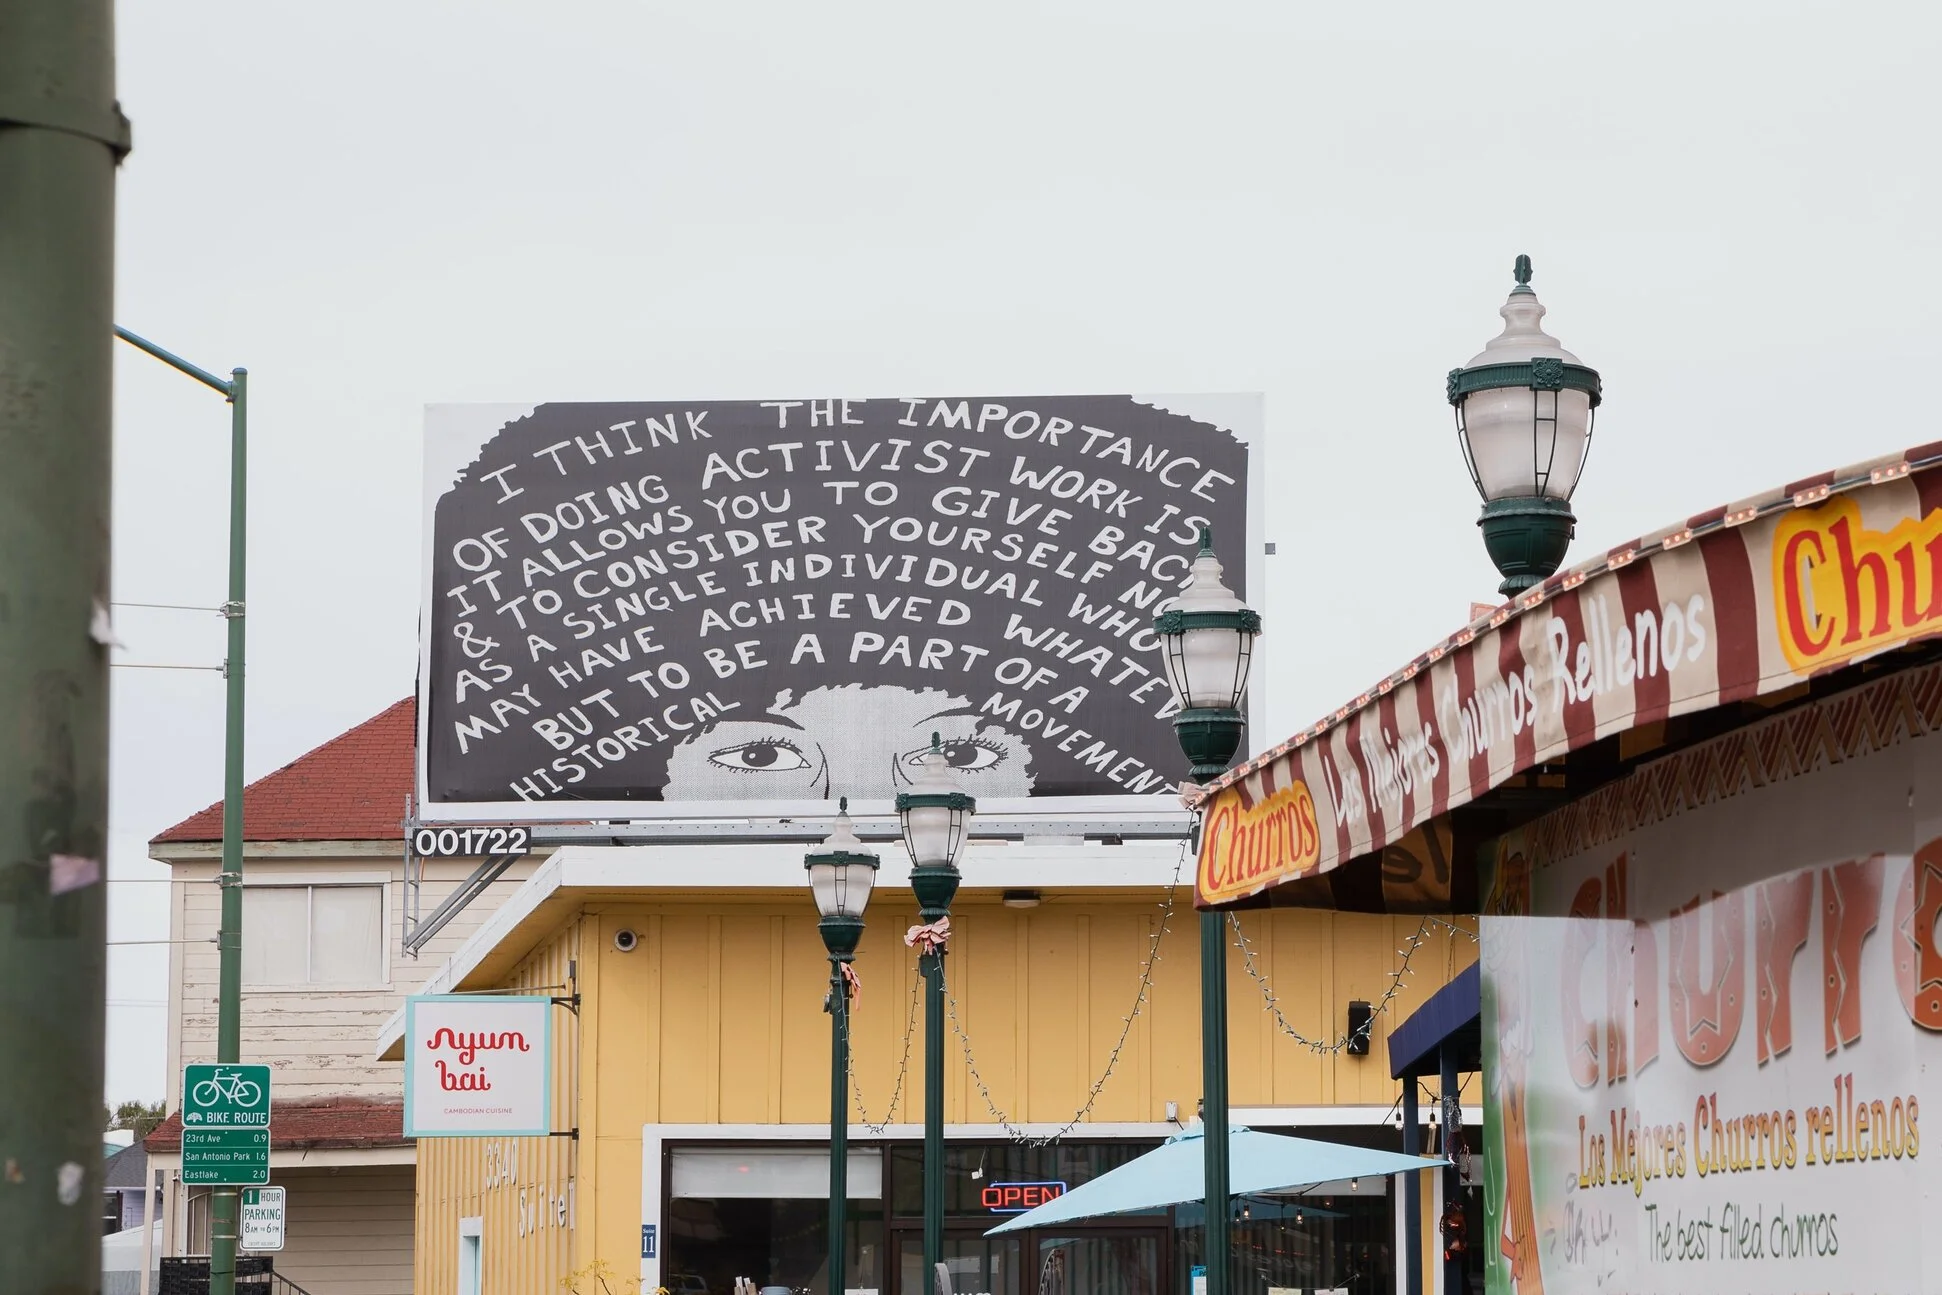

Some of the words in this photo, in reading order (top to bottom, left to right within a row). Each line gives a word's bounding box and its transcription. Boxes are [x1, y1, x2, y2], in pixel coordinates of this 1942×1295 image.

[480, 464, 524, 504] I
[533, 411, 712, 475] THINK
[760, 398, 867, 428] THE
[898, 398, 1235, 502] IMPORTANCE
[453, 528, 509, 571] OF
[520, 475, 669, 543] DOING
[702, 439, 990, 490] ACTIVIST
[1010, 456, 1143, 518] WORK
[1144, 504, 1211, 545] IS
[447, 570, 502, 617] IT
[523, 506, 693, 587] ALLOWS
[703, 489, 790, 524] YOU
[823, 482, 898, 505] TO
[932, 487, 1072, 535] GIVE
[454, 622, 500, 658] &
[496, 590, 562, 629] TO
[574, 516, 826, 598] CONSIDER
[853, 514, 1113, 583] YOURSELF
[1783, 515, 1942, 656] Chu
[456, 659, 512, 703] AS
[527, 635, 557, 662] A
[563, 571, 726, 639] SINGLE
[743, 554, 1043, 606] INDIVIDUAL
[1068, 593, 1162, 652] WHO
[455, 684, 541, 754] MAY
[548, 626, 664, 688] HAVE
[700, 593, 971, 637] ACHIEVED
[532, 689, 619, 750] BUT
[627, 663, 690, 698] TO
[704, 641, 767, 678] BE
[790, 634, 825, 664] A
[850, 632, 989, 671] PART
[995, 658, 1058, 690] OF
[1048, 686, 1089, 713] A
[1441, 664, 1538, 765] Churros
[1546, 594, 1706, 713] Rellenos
[509, 692, 740, 801] HISTORICAL
[980, 692, 1179, 795] MOVEMENT
[415, 828, 527, 855] 001722
[1208, 797, 1316, 890] Churros
[427, 1027, 530, 1065] Nyum
[435, 1059, 491, 1091] bai
[185, 1134, 204, 1143] 23rd
[207, 1135, 221, 1143] Ave
[253, 1134, 267, 1143] 0.9
[207, 1112, 229, 1123] BIKE
[234, 1112, 266, 1124] ROUTE
[1578, 1115, 1606, 1189] Los
[1610, 1107, 1687, 1198] Mejores
[1694, 1092, 1796, 1178] Churros
[1805, 1072, 1919, 1165] rellenos
[185, 1152, 200, 1161] San
[202, 1152, 231, 1161] Antonio
[233, 1152, 250, 1161] Park
[256, 1152, 266, 1161] 1.6
[185, 1170, 218, 1179] Eastlake
[253, 1170, 266, 1179] 2.0
[487, 1139, 517, 1189] 3340
[244, 1209, 281, 1220] PARKING
[248, 1190, 253, 1204] 1
[261, 1192, 281, 1202] HOUR
[982, 1186, 1060, 1207] OPEN
[643, 1235, 654, 1253] 11
[1645, 1203, 1671, 1264] The
[1676, 1209, 1713, 1263] best
[1720, 1202, 1762, 1260] filled
[1770, 1202, 1838, 1260] churros
